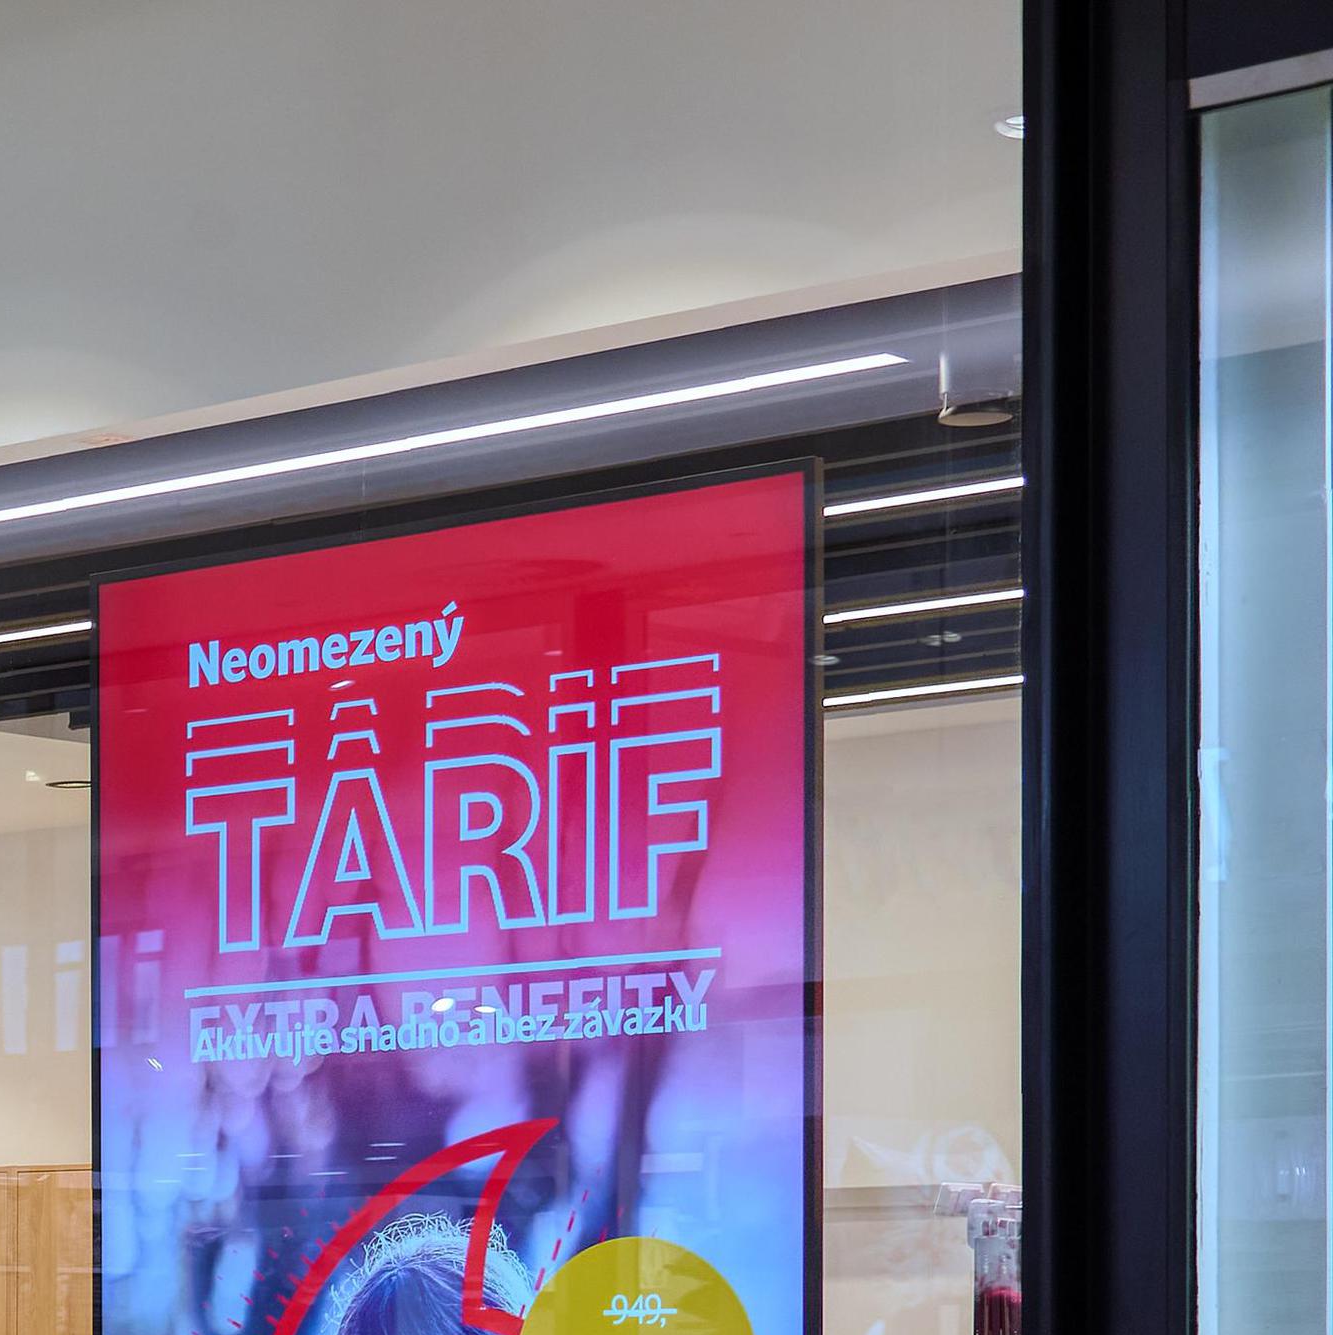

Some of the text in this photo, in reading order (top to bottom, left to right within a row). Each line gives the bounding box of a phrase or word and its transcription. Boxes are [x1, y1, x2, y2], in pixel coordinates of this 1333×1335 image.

[187, 601, 464, 688] Neomezený
[185, 727, 722, 954] TARIF
[191, 996, 707, 1066] Aktivujte snadno a bez závazku
